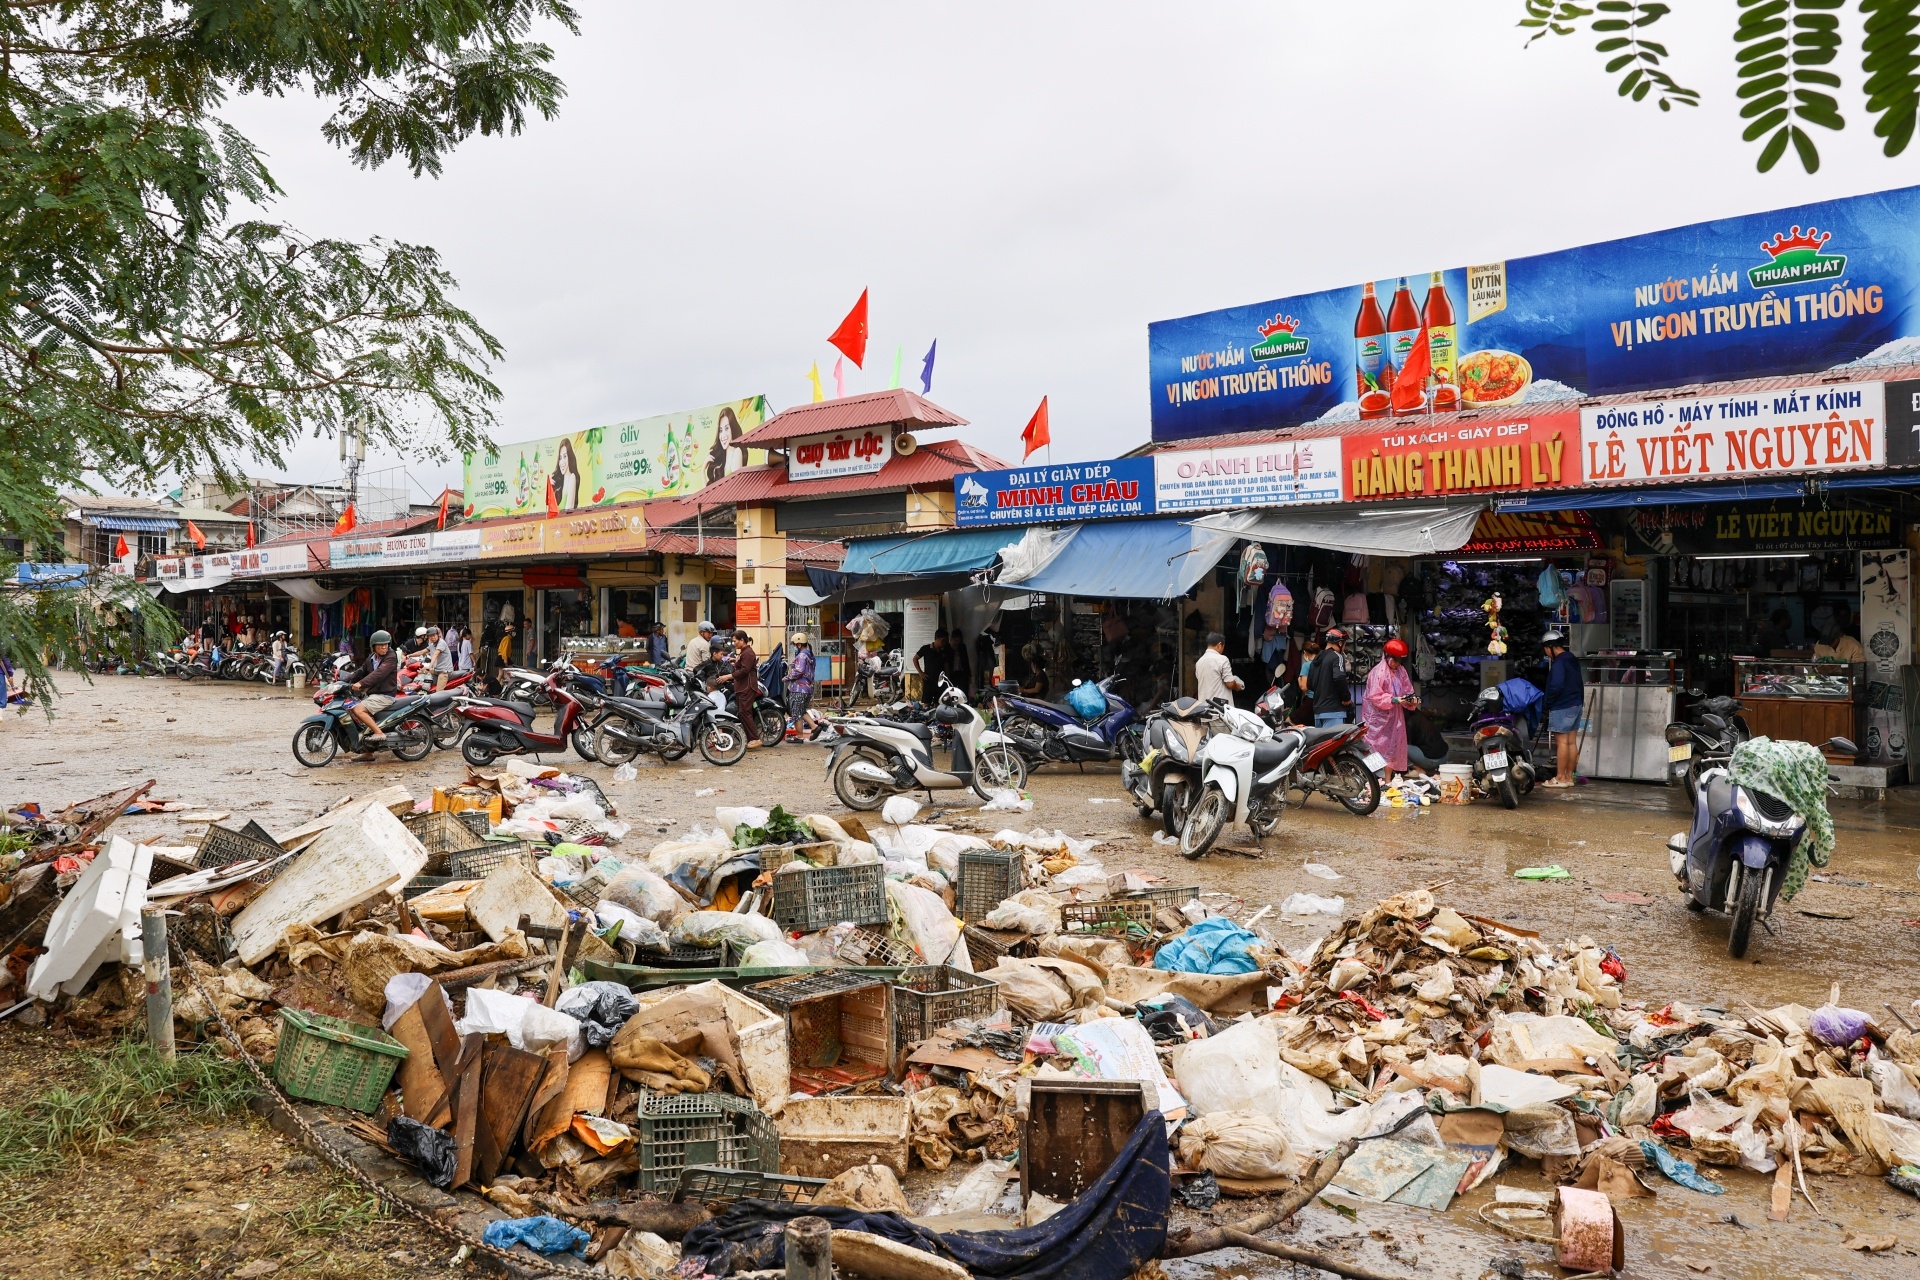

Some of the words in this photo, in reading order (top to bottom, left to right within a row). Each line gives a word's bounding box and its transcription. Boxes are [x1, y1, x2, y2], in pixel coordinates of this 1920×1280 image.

[1471, 277, 1486, 291] UY
[1486, 273, 1501, 288] TÍN
[1635, 277, 1689, 308] NƯỚC
[1691, 263, 1738, 298] MẮM
[1754, 266, 1800, 282] THUẬN
[1802, 258, 1840, 276] PHÁT
[1472, 290, 1486, 302] LÂU
[1486, 289, 1501, 300] NĂM
[1611, 320, 1633, 350] VỊ
[1636, 312, 1697, 344] NGON
[1700, 290, 1792, 334] TRUYỀN
[1794, 279, 1884, 323] THỐNG
[1181, 350, 1214, 373] NƯỚC
[1216, 341, 1245, 368] MẮM
[1254, 343, 1283, 357] THUẬN
[1284, 340, 1306, 353] PHÁT
[1166, 382, 1180, 407] VỊ
[1182, 378, 1219, 402] NGON
[1221, 364, 1277, 396] TRUYỀN
[1279, 357, 1332, 389] THỐNG
[1597, 405, 1638, 430] ĐỒNG
[1643, 402, 1665, 426] HỒ
[1680, 400, 1714, 423] MÁY
[1719, 396, 1759, 420] TÍNH
[1773, 389, 1808, 415] MẮT
[1816, 388, 1861, 411] KÍNH
[796, 441, 825, 468] CHỢ
[826, 434, 853, 462] TÂY
[854, 431, 883, 462] LỘC
[1381, 433, 1405, 448] TÚI
[1408, 430, 1448, 446] XÁCH
[1457, 424, 1493, 441] GIÀY
[1497, 421, 1529, 437] DÉP
[1589, 430, 1627, 480] LÊ
[1637, 422, 1715, 477] VIẾT
[1725, 411, 1874, 471] NGUYÊN
[1009, 472, 1030, 488] ĐẠI
[1034, 470, 1048, 483] LÝ
[1051, 465, 1081, 482] GIÀY
[1085, 463, 1111, 480] DÉP
[1177, 457, 1250, 479] OANH
[1256, 443, 1315, 473] HUẾ
[1351, 449, 1424, 497] HÀNG
[1428, 443, 1522, 491] THANH
[1530, 431, 1565, 484] LÝ
[990, 507, 1022, 520] CHUYÊN
[1035, 509, 1042, 517] &
[1058, 503, 1077, 517] GIÀY
[1079, 501, 1097, 515] DÉP
[1100, 500, 1119, 514] CÁC
[1121, 500, 1142, 515] LOẠI
[996, 486, 1063, 509] MINH
[1070, 478, 1139, 504] CHÂU
[1716, 506, 1741, 539] LÊ
[1746, 498, 1792, 538] VIẾT
